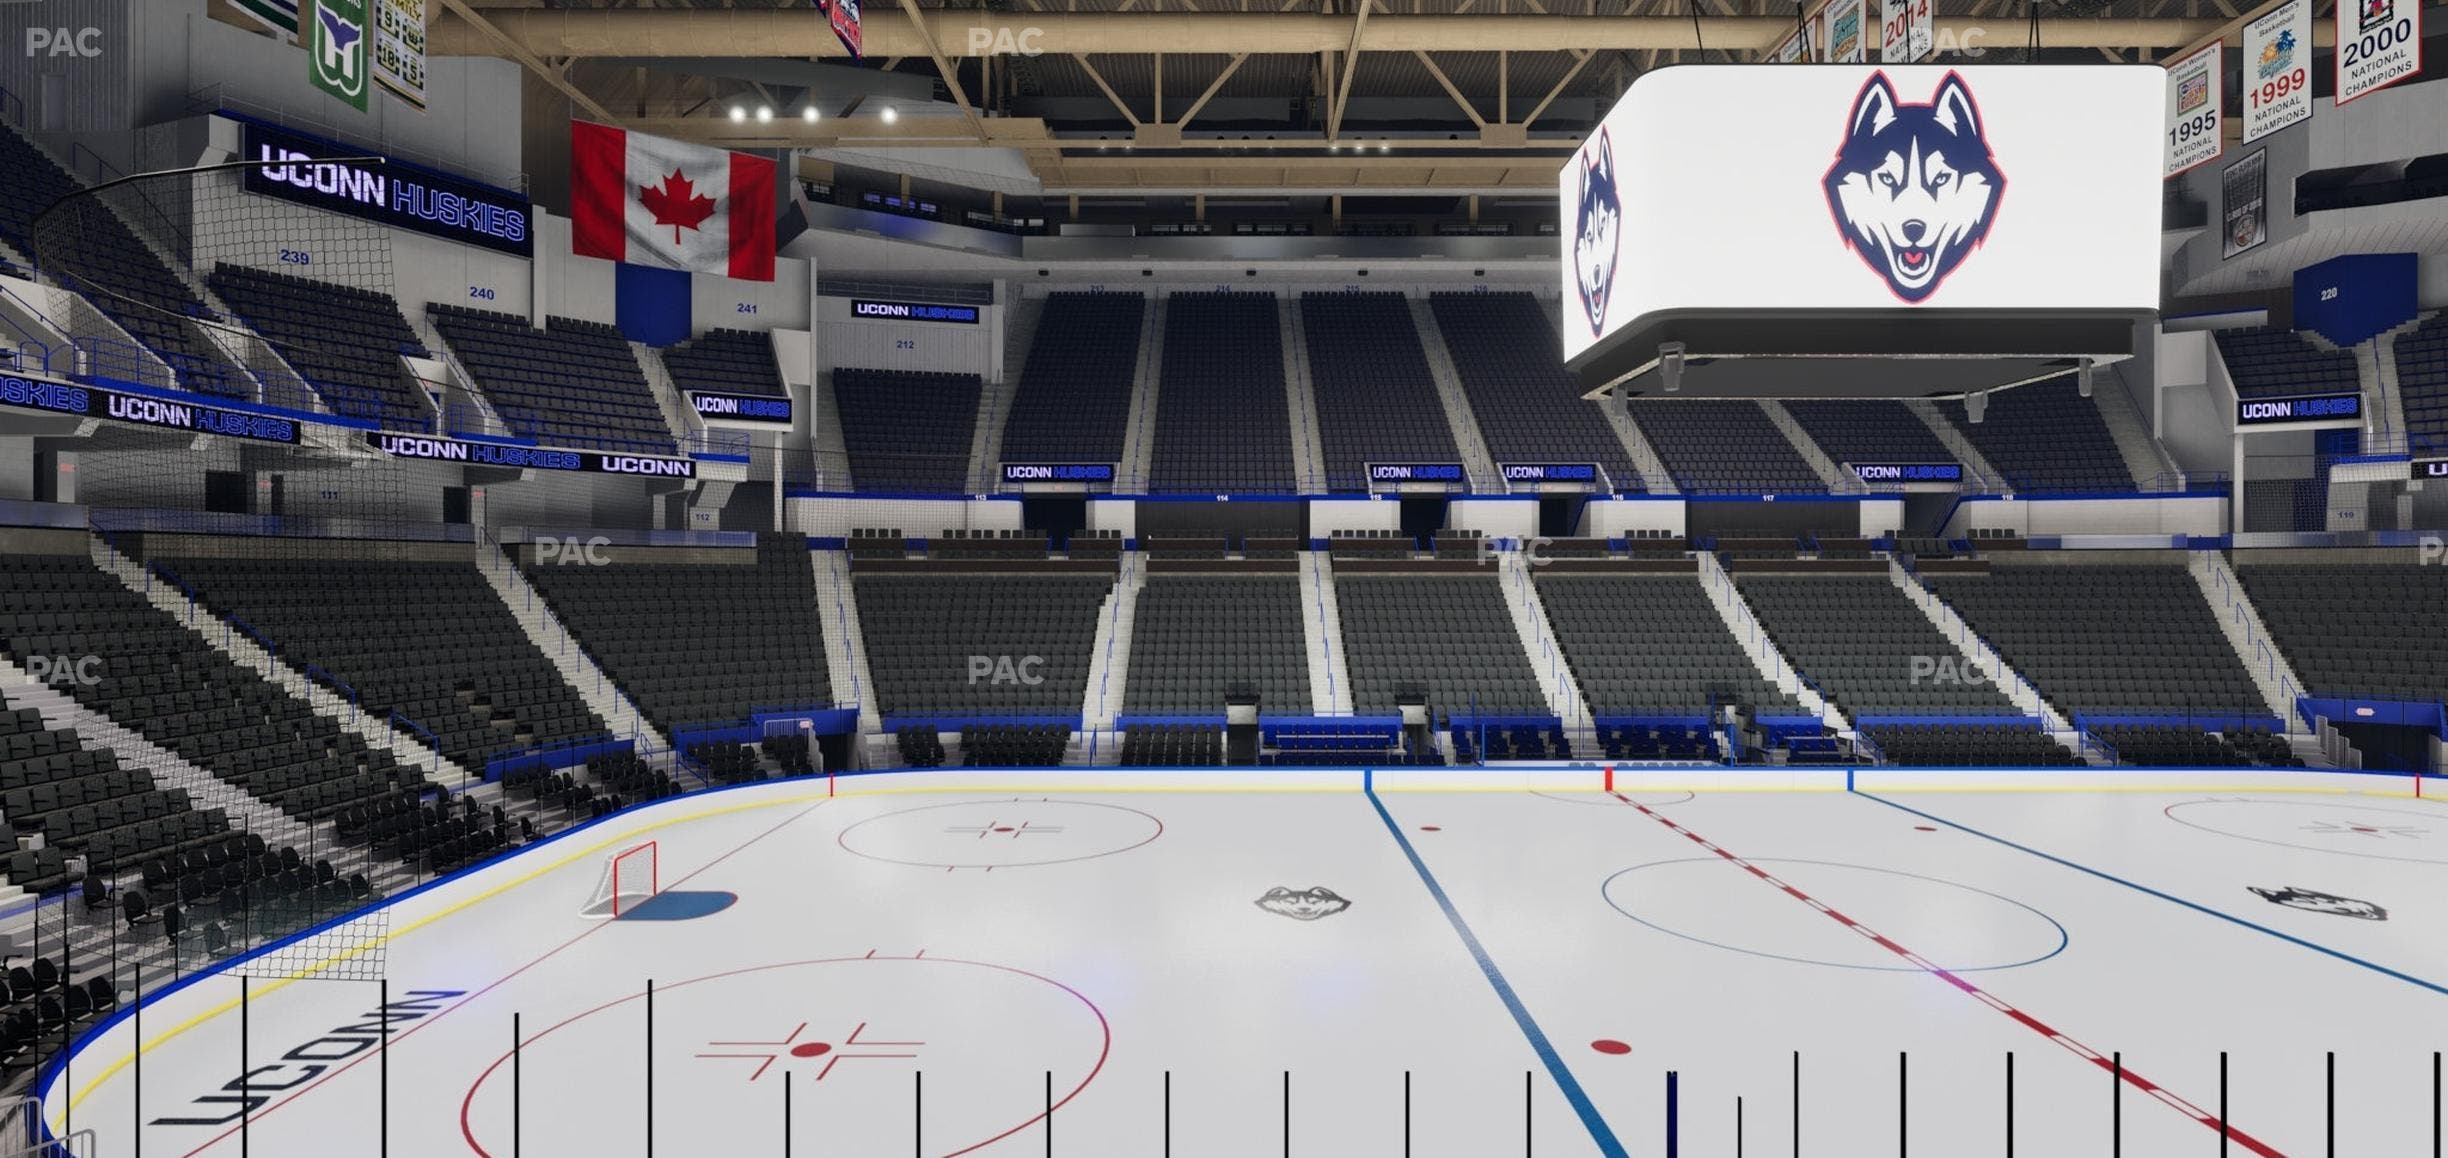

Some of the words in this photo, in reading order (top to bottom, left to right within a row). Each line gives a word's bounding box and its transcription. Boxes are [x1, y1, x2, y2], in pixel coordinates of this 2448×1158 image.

[2343, 18, 2411, 68] 2000
[2351, 49, 2407, 79] NATIONAL
[2345, 61, 2412, 96] CHAMPIONS
[2250, 68, 2305, 109] 1999
[2255, 96, 2301, 122] NATIONAL
[2169, 109, 2216, 146] 1995
[2250, 107, 2306, 137] CHAMPIONS
[2173, 136, 2212, 159] NATIONAL
[2169, 146, 2217, 172] CHAMPIONS
[262, 144, 385, 207] UCONN
[393, 179, 525, 241] HUSKIES
[280, 249, 310, 265] 239
[469, 286, 496, 301] 240
[2321, 287, 2338, 301] 220
[737, 303, 757, 314] 241
[857, 303, 909, 316] UCONN
[896, 340, 914, 349] 212
[0, 377, 88, 412] SKIES
[696, 396, 737, 414] UCONN
[2243, 402, 2291, 418] UCONN
[109, 395, 190, 427] UCONN
[195, 408, 293, 441] HUSKIES
[381, 435, 467, 460] UCONN
[472, 444, 580, 469] HUSKIES
[602, 456, 691, 476] UCONN
[1007, 466, 1052, 478] UCONN
[1373, 466, 1411, 478] UCONN
[1506, 466, 1543, 478] UCONN
[1856, 466, 1900, 478] UCONN
[1216, 494, 1229, 502] 114
[1763, 494, 1774, 502] 117
[696, 512, 710, 521] 112
[2337, 511, 2354, 519] 119
[147, 990, 468, 1125] UCONN
